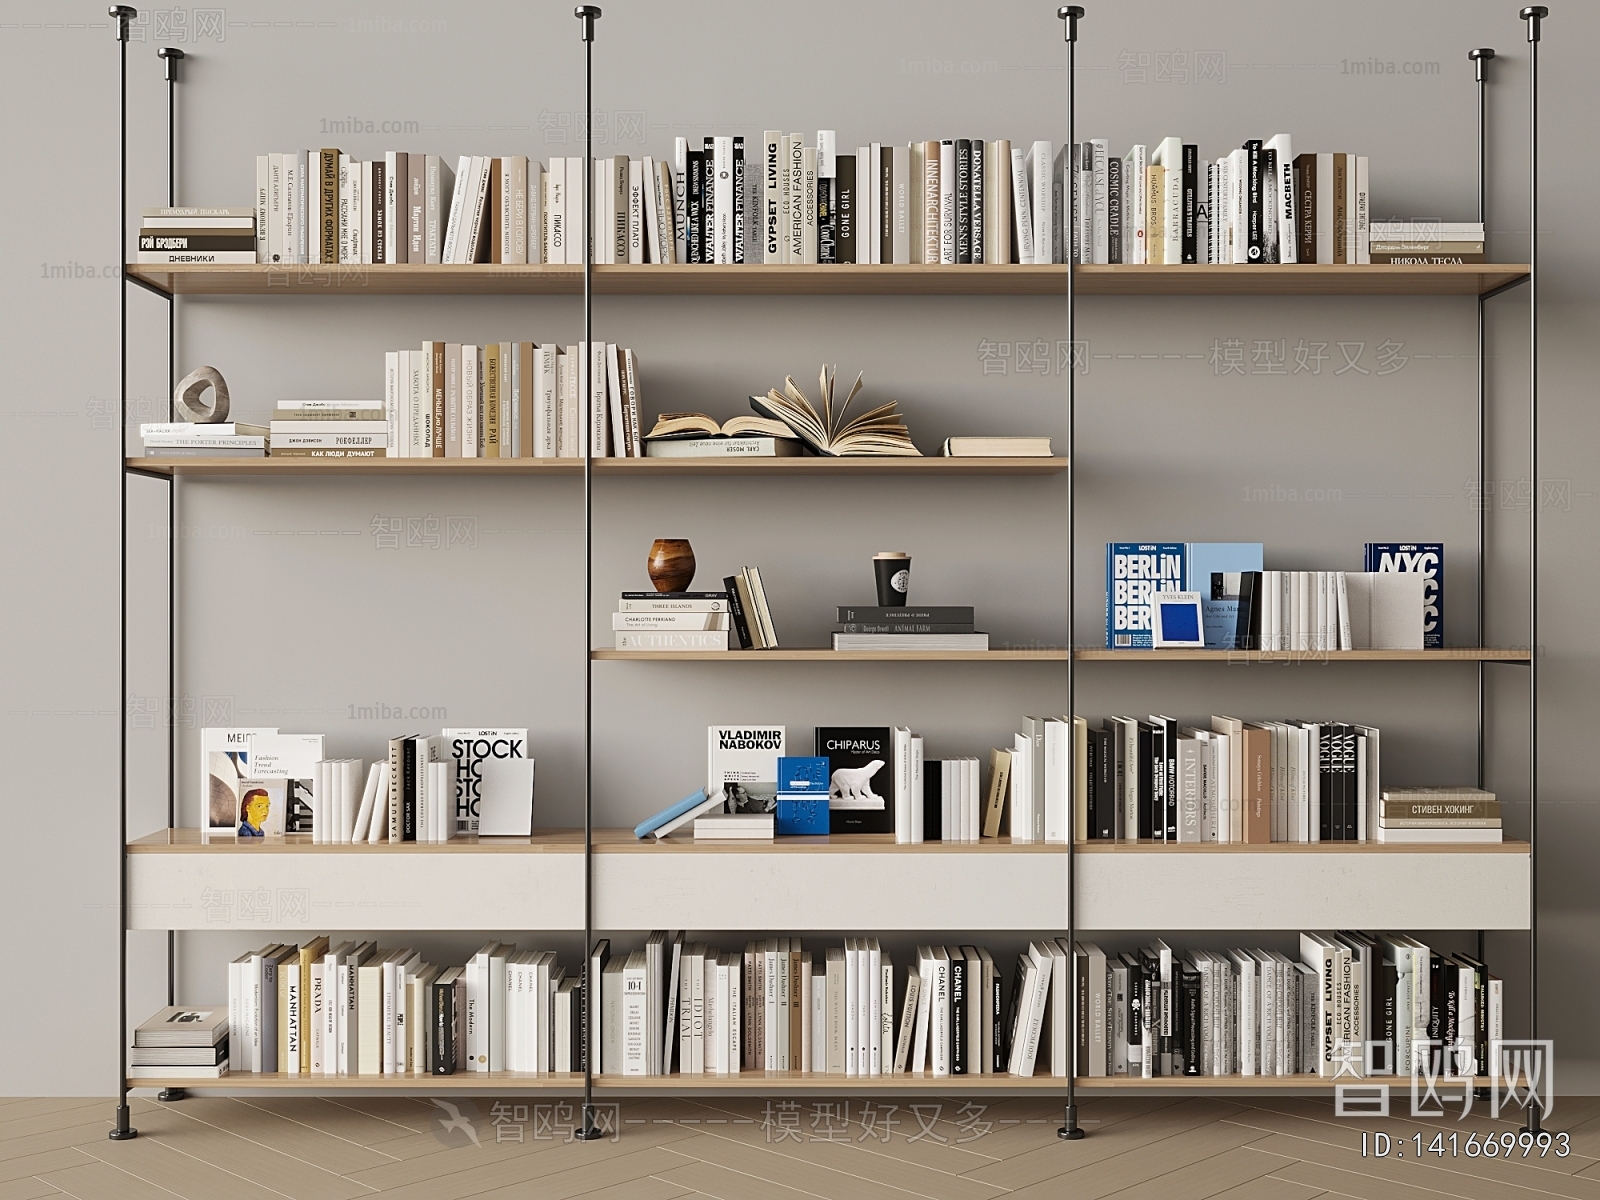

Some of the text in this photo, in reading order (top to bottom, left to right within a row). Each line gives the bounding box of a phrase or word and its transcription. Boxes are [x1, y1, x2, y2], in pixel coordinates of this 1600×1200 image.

[324, 152, 336, 179] ДУМАЙ
[1095, 150, 1105, 188] BECAUSE
[1110, 161, 1119, 197] COSMIC
[324, 188, 334, 217] ДРУГИХ
[516, 189, 523, 199] НЕ
[676, 172, 685, 241] MUNCH
[768, 143, 777, 254] GYPSET LIVING
[782, 168, 790, 214] ECO HOUSES
[792, 141, 802, 256] AMERICAN FASHION
[959, 148, 968, 256] MEN'S STYLE STORIES
[972, 150, 982, 259] DONATELLA VERSACE
[1095, 196, 1105, 215] YOU
[1283, 163, 1293, 220] MACBETH
[1305, 190, 1313, 218] СЕСТРА
[412, 206, 421, 232] Мартин
[704, 159, 714, 262] WALTER FINANCE
[735, 159, 744, 262] WALTER FINANCE
[841, 189, 851, 238] GONE GIRL
[926, 159, 939, 263] INNENARCHITEKTUR
[944, 193, 952, 262] ART FOR SURVIVAL
[1109, 198, 1119, 236] CRADLE
[1172, 177, 1180, 242] BARRACUDA
[1196, 204, 1209, 219] A
[141, 236, 188, 250] РЭЙ БРЭДБЕРИ
[325, 219, 334, 259] ФОРМАТАХ
[412, 234, 421, 252] Иден
[515, 226, 523, 255] ГОЛОВУ
[554, 214, 562, 248] ПИКАССО
[616, 211, 626, 257] ПИКАССО
[169, 255, 215, 263] ДНЕВНИКИ
[466, 360, 475, 445] НОВЫЙ ОБРАЗ ЖИЗНИ
[488, 358, 499, 444] БОЖЕСТВЕННАЯ КОМЕДИЯ РАЙ
[513, 388, 521, 419] Избранное
[545, 390, 553, 434] Триумфальная
[595, 391, 603, 451] Братья Карамазовы
[325, 451, 344, 459] ЛЮДИ
[346, 451, 375, 459] ДУМАЮТ
[336, 436, 373, 445] РОКФЕЛЛЕР
[1379, 552, 1439, 580] NYC
[629, 634, 722, 647] AUTHENTICS
[863, 625, 889, 634] George Orwell
[894, 624, 931, 633] ANIMAL FARM
[451, 738, 524, 759] STOCK
[718, 730, 782, 740] VLADIMIR
[719, 740, 782, 750] NABOKOV
[826, 739, 881, 751] CHIPARUS
[1035, 734, 1043, 747] Dior
[1319, 734, 1331, 773] VOGUE
[1331, 734, 1343, 773] VOGUE
[1343, 734, 1355, 773] VOGUE
[253, 768, 289, 776] Forecasting
[1168, 775, 1176, 806] MOTORRAD
[1184, 757, 1197, 826] INTERIORS
[1210, 780, 1218, 831] ATMOSPHERE
[1411, 805, 1473, 814] СТИВЕН ХОКИНГ
[938, 966, 946, 1002] CHANEL
[954, 966, 962, 1002] CHANEL
[1446, 990, 1456, 999] To
[289, 985, 297, 1052] MANHATTAN
[882, 1012, 893, 1034] Lolita
[904, 985, 917, 1028] LOUIS VUITTON
[1343, 957, 1351, 1064] AMERICAN FASHION
[1385, 997, 1393, 1043] GONE GIRL
[1431, 1006, 1439, 1039] INIQUITY
[1445, 999, 1455, 1011] Kill
[1029, 1018, 1040, 1046] PICOULT
